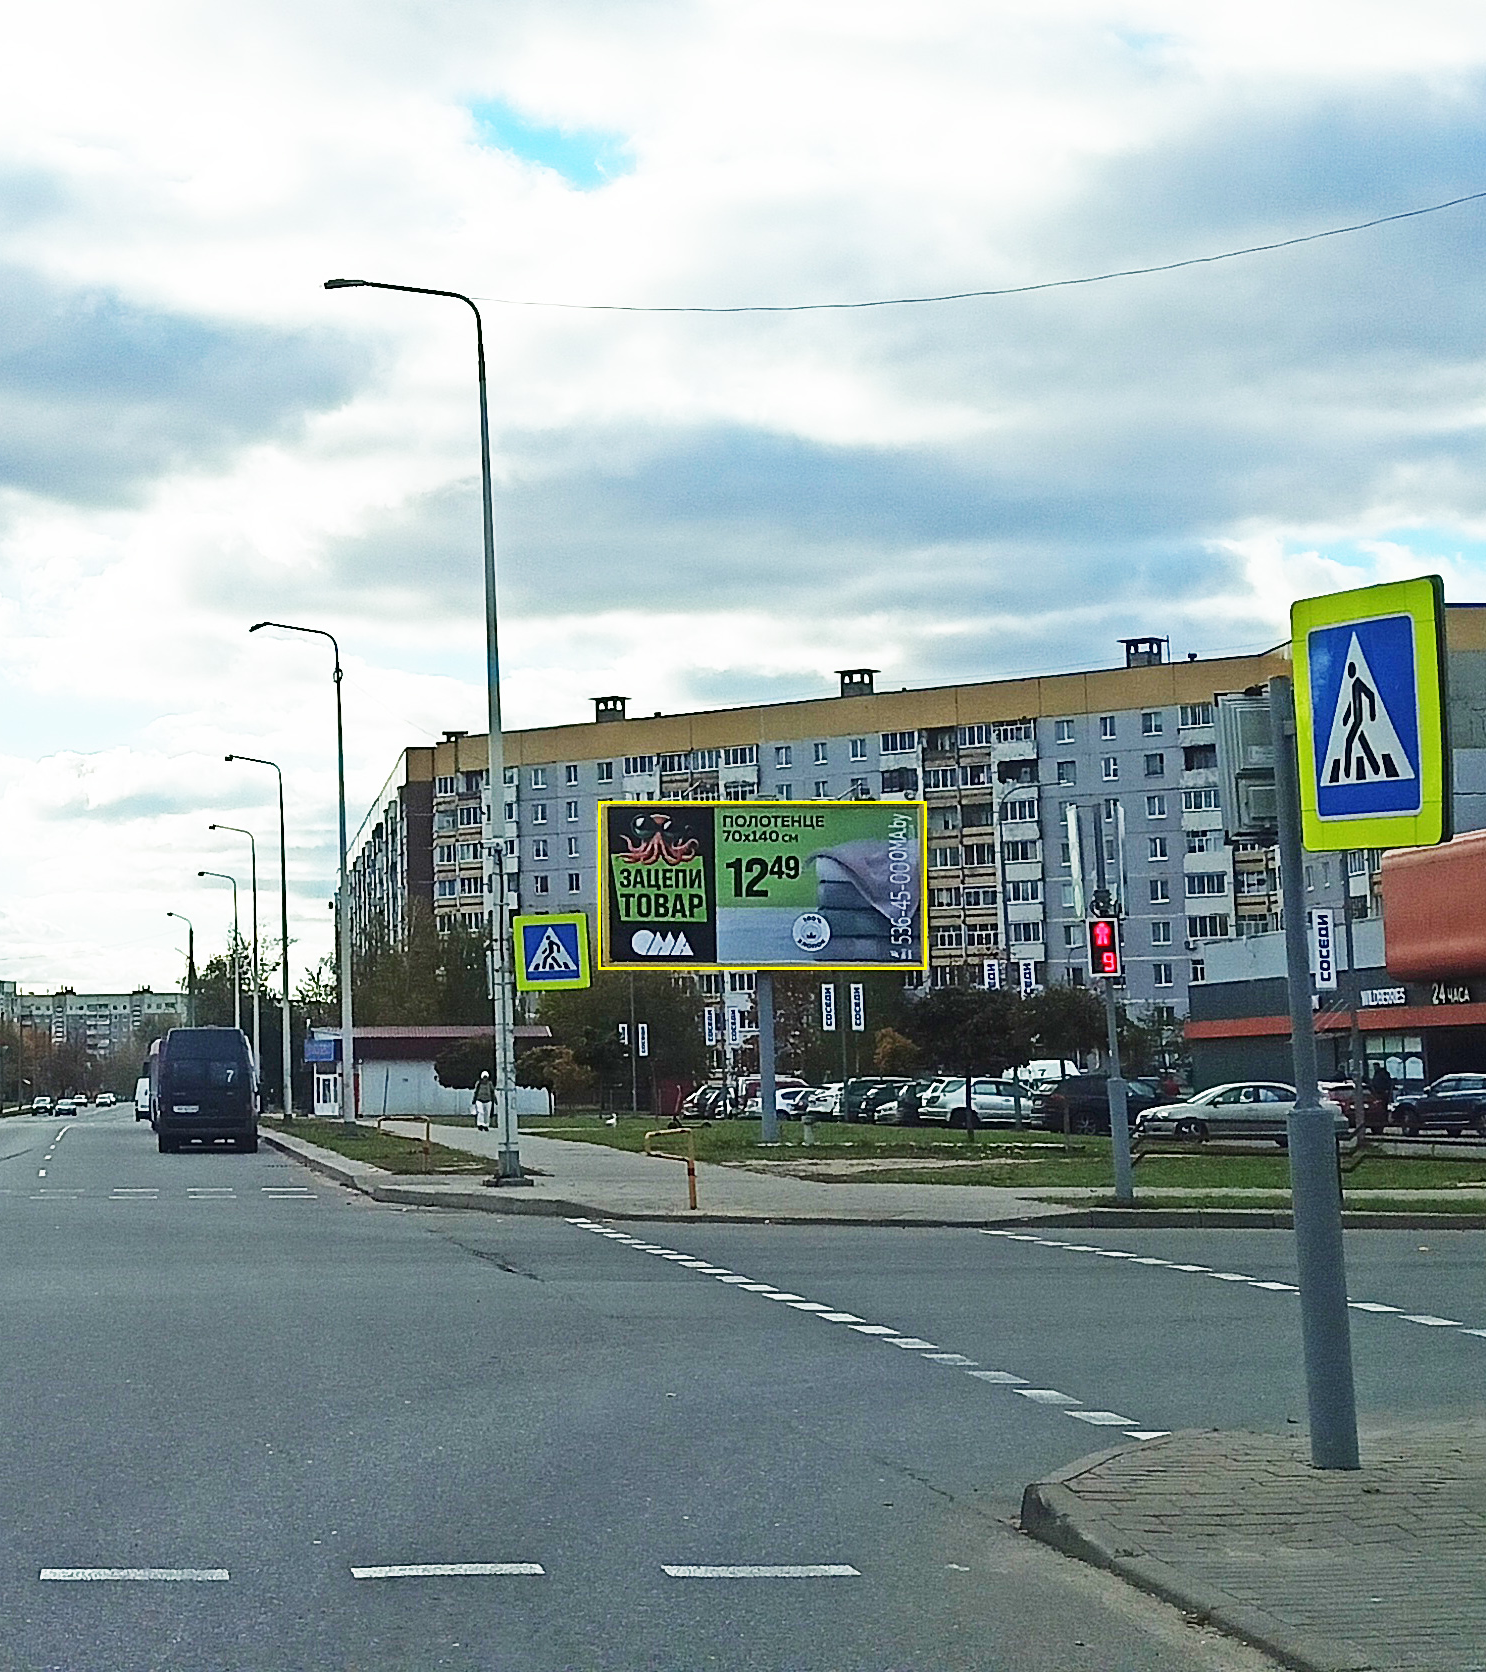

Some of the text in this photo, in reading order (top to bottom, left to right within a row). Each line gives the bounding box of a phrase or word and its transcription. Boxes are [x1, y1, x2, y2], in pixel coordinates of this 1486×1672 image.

[722, 815, 825, 830] ПОЛОТЕНЦЕ
[781, 834, 799, 843] см
[619, 869, 703, 891] ЗАЦЕПИ
[619, 893, 704, 918] ТОВАР
[1317, 914, 1332, 982] СОСЕДИ
[1103, 952, 1116, 972] 9
[1431, 983, 1471, 1005] 24 ЧАСА
[824, 987, 833, 1027] СОСЕДИ
[853, 986, 862, 1027] СОСЕДИ
[226, 1069, 234, 1083] 7
